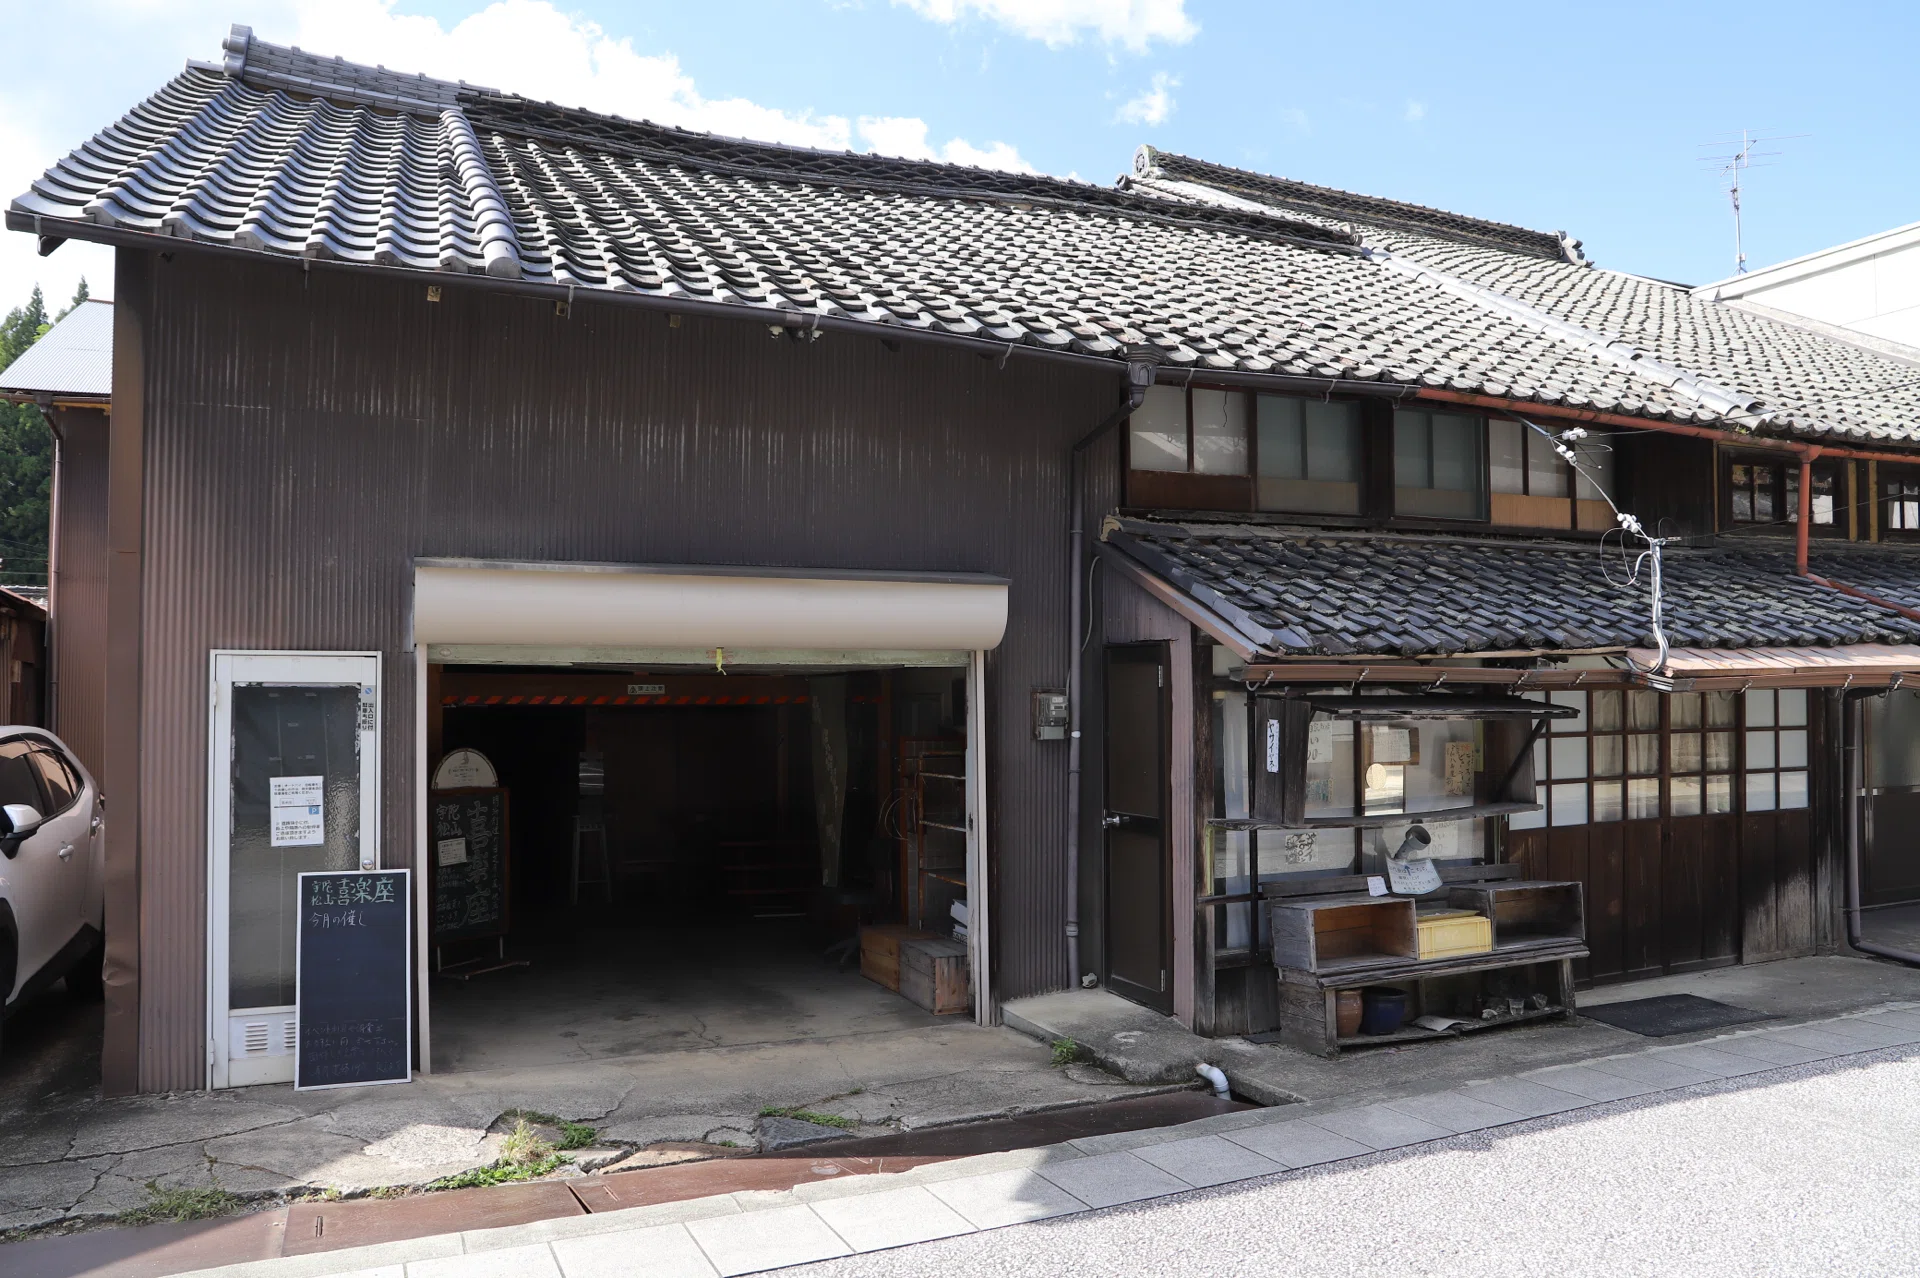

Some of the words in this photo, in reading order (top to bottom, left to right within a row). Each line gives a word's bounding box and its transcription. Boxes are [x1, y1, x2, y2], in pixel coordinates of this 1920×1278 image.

[436, 803, 461, 821] 宇陀
[436, 821, 463, 838] 松山
[311, 880, 333, 893] 宇陀
[336, 876, 395, 906] 喜楽座
[311, 894, 335, 906] 松山
[309, 909, 367, 928] 今月の催し
